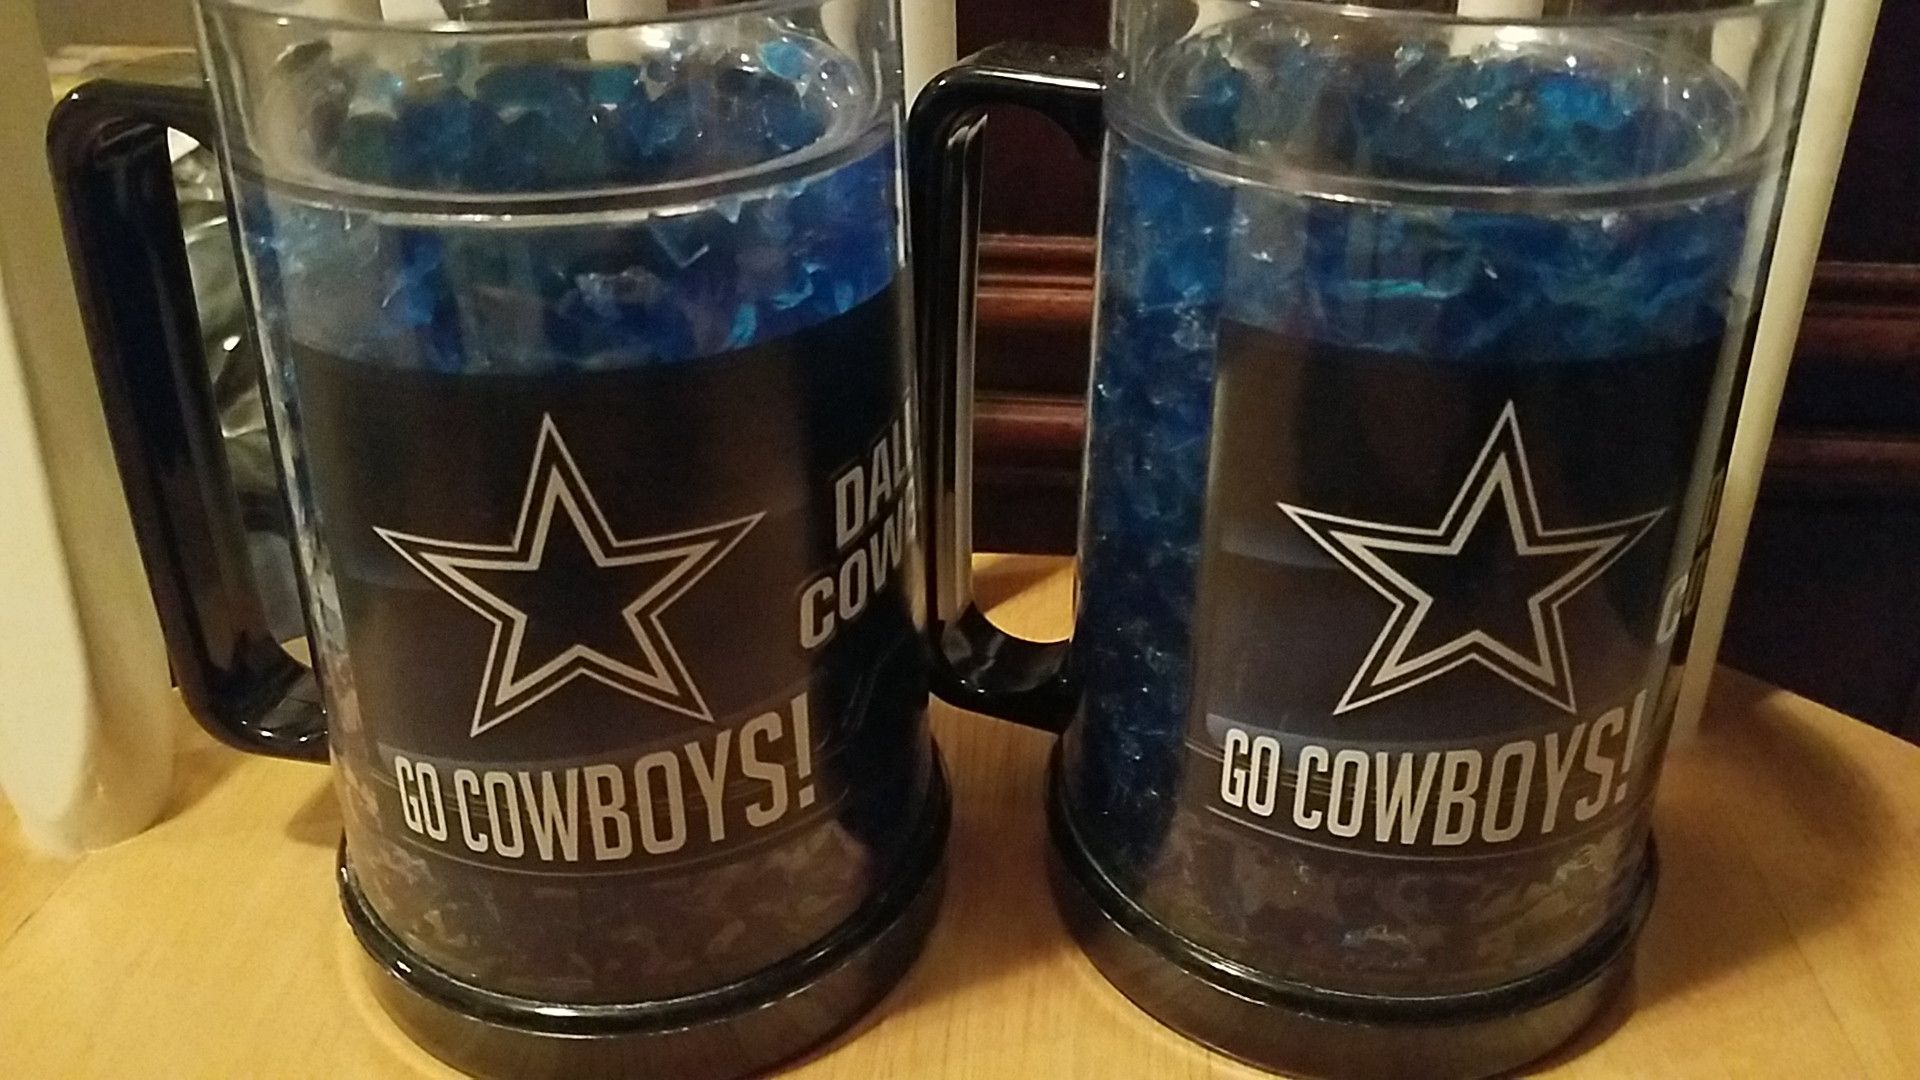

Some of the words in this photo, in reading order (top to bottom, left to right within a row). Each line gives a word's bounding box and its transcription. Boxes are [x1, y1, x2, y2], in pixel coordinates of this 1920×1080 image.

[394, 755, 448, 842] GO
[453, 691, 815, 862] COWBOYS!
[1221, 728, 1281, 817] GO
[1293, 689, 1646, 846] COWBOYS!
